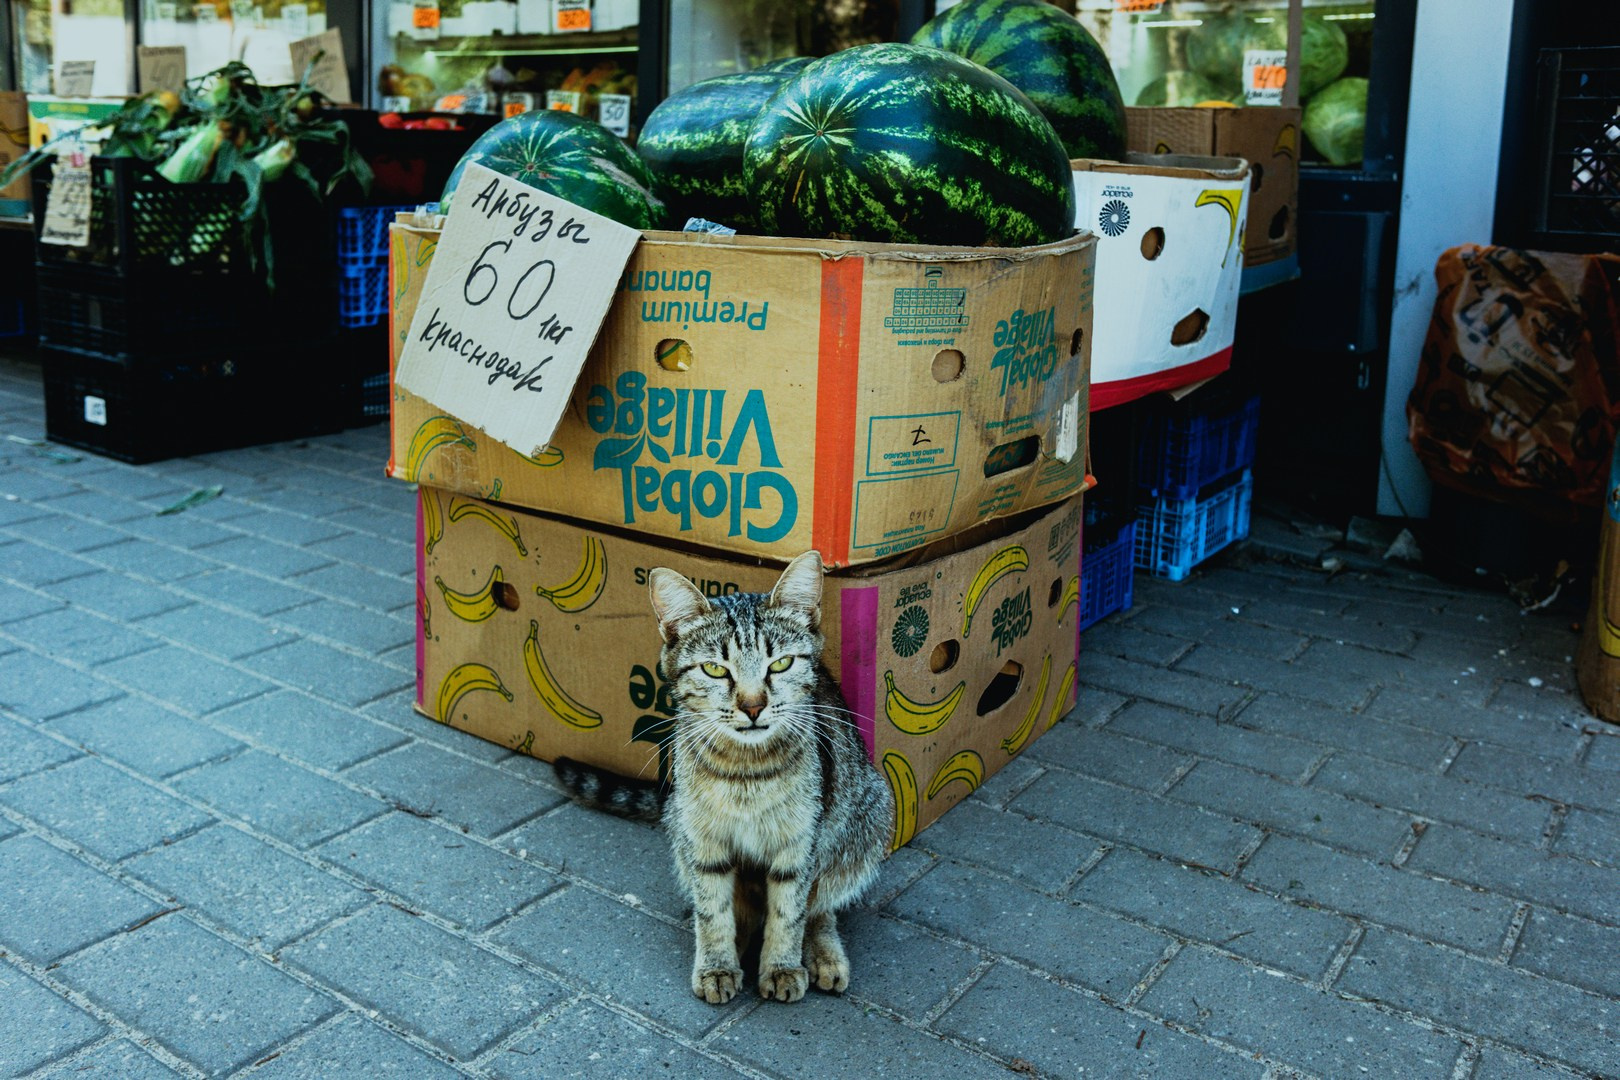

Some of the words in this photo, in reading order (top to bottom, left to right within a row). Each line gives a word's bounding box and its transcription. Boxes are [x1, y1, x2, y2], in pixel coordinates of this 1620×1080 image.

[464, 239, 556, 320] 60
[641, 301, 769, 331] Premium
[993, 306, 1056, 349] Village
[991, 347, 1057, 398] Global
[587, 370, 784, 468] Village
[594, 456, 798, 543] Global
[893, 588, 932, 608] ecuador
[992, 585, 1031, 628] Village
[991, 611, 1033, 658] Global
